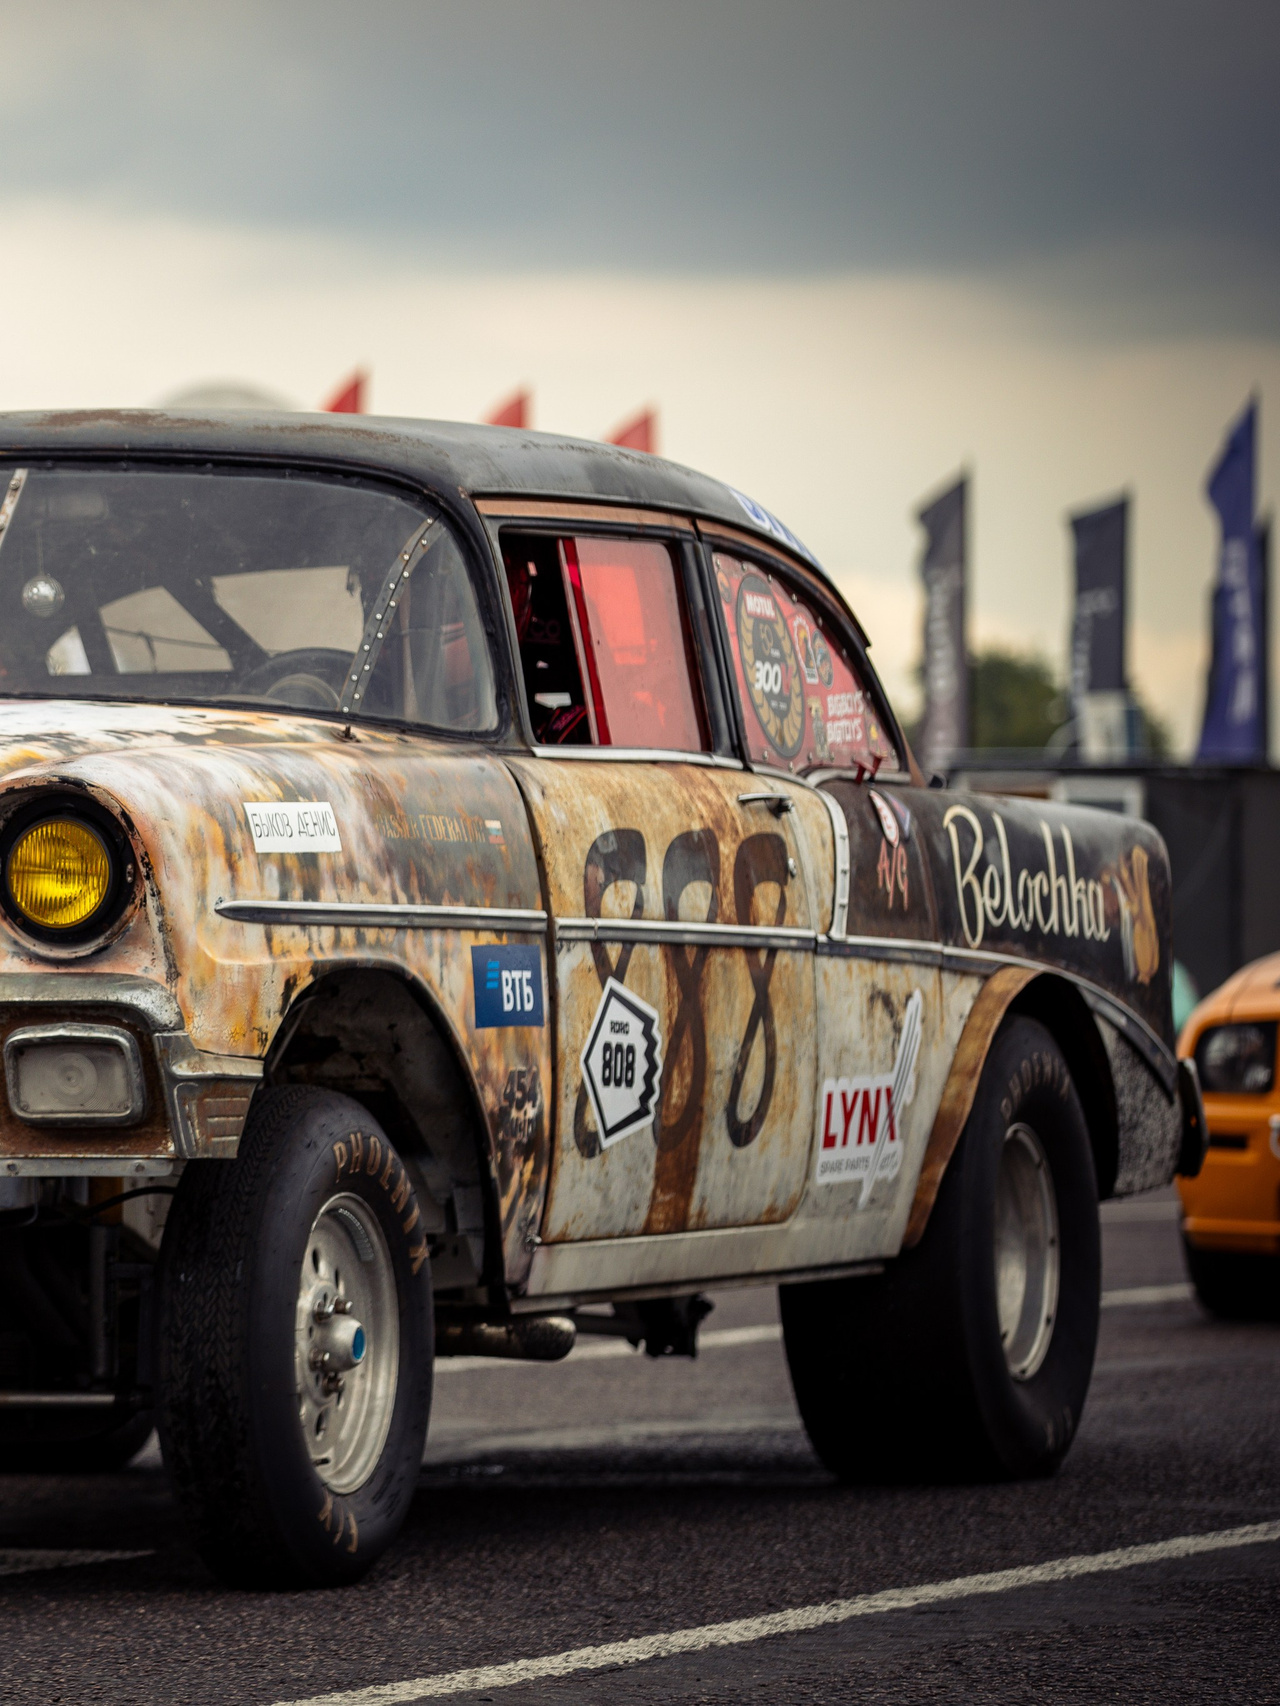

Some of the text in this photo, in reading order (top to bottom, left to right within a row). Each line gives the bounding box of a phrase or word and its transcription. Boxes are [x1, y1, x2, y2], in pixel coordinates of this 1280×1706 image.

[745, 593, 776, 619] MOTUL
[754, 660, 793, 696] 300V
[251, 811, 336, 838] БЫКОВ ДЕНИС
[943, 804, 1111, 949] Belochka
[501, 970, 534, 1013] ВТБ
[602, 1042, 635, 1088] 808
[822, 1085, 897, 1150] LYNX
[332, 1131, 430, 1276] PHOENIX
